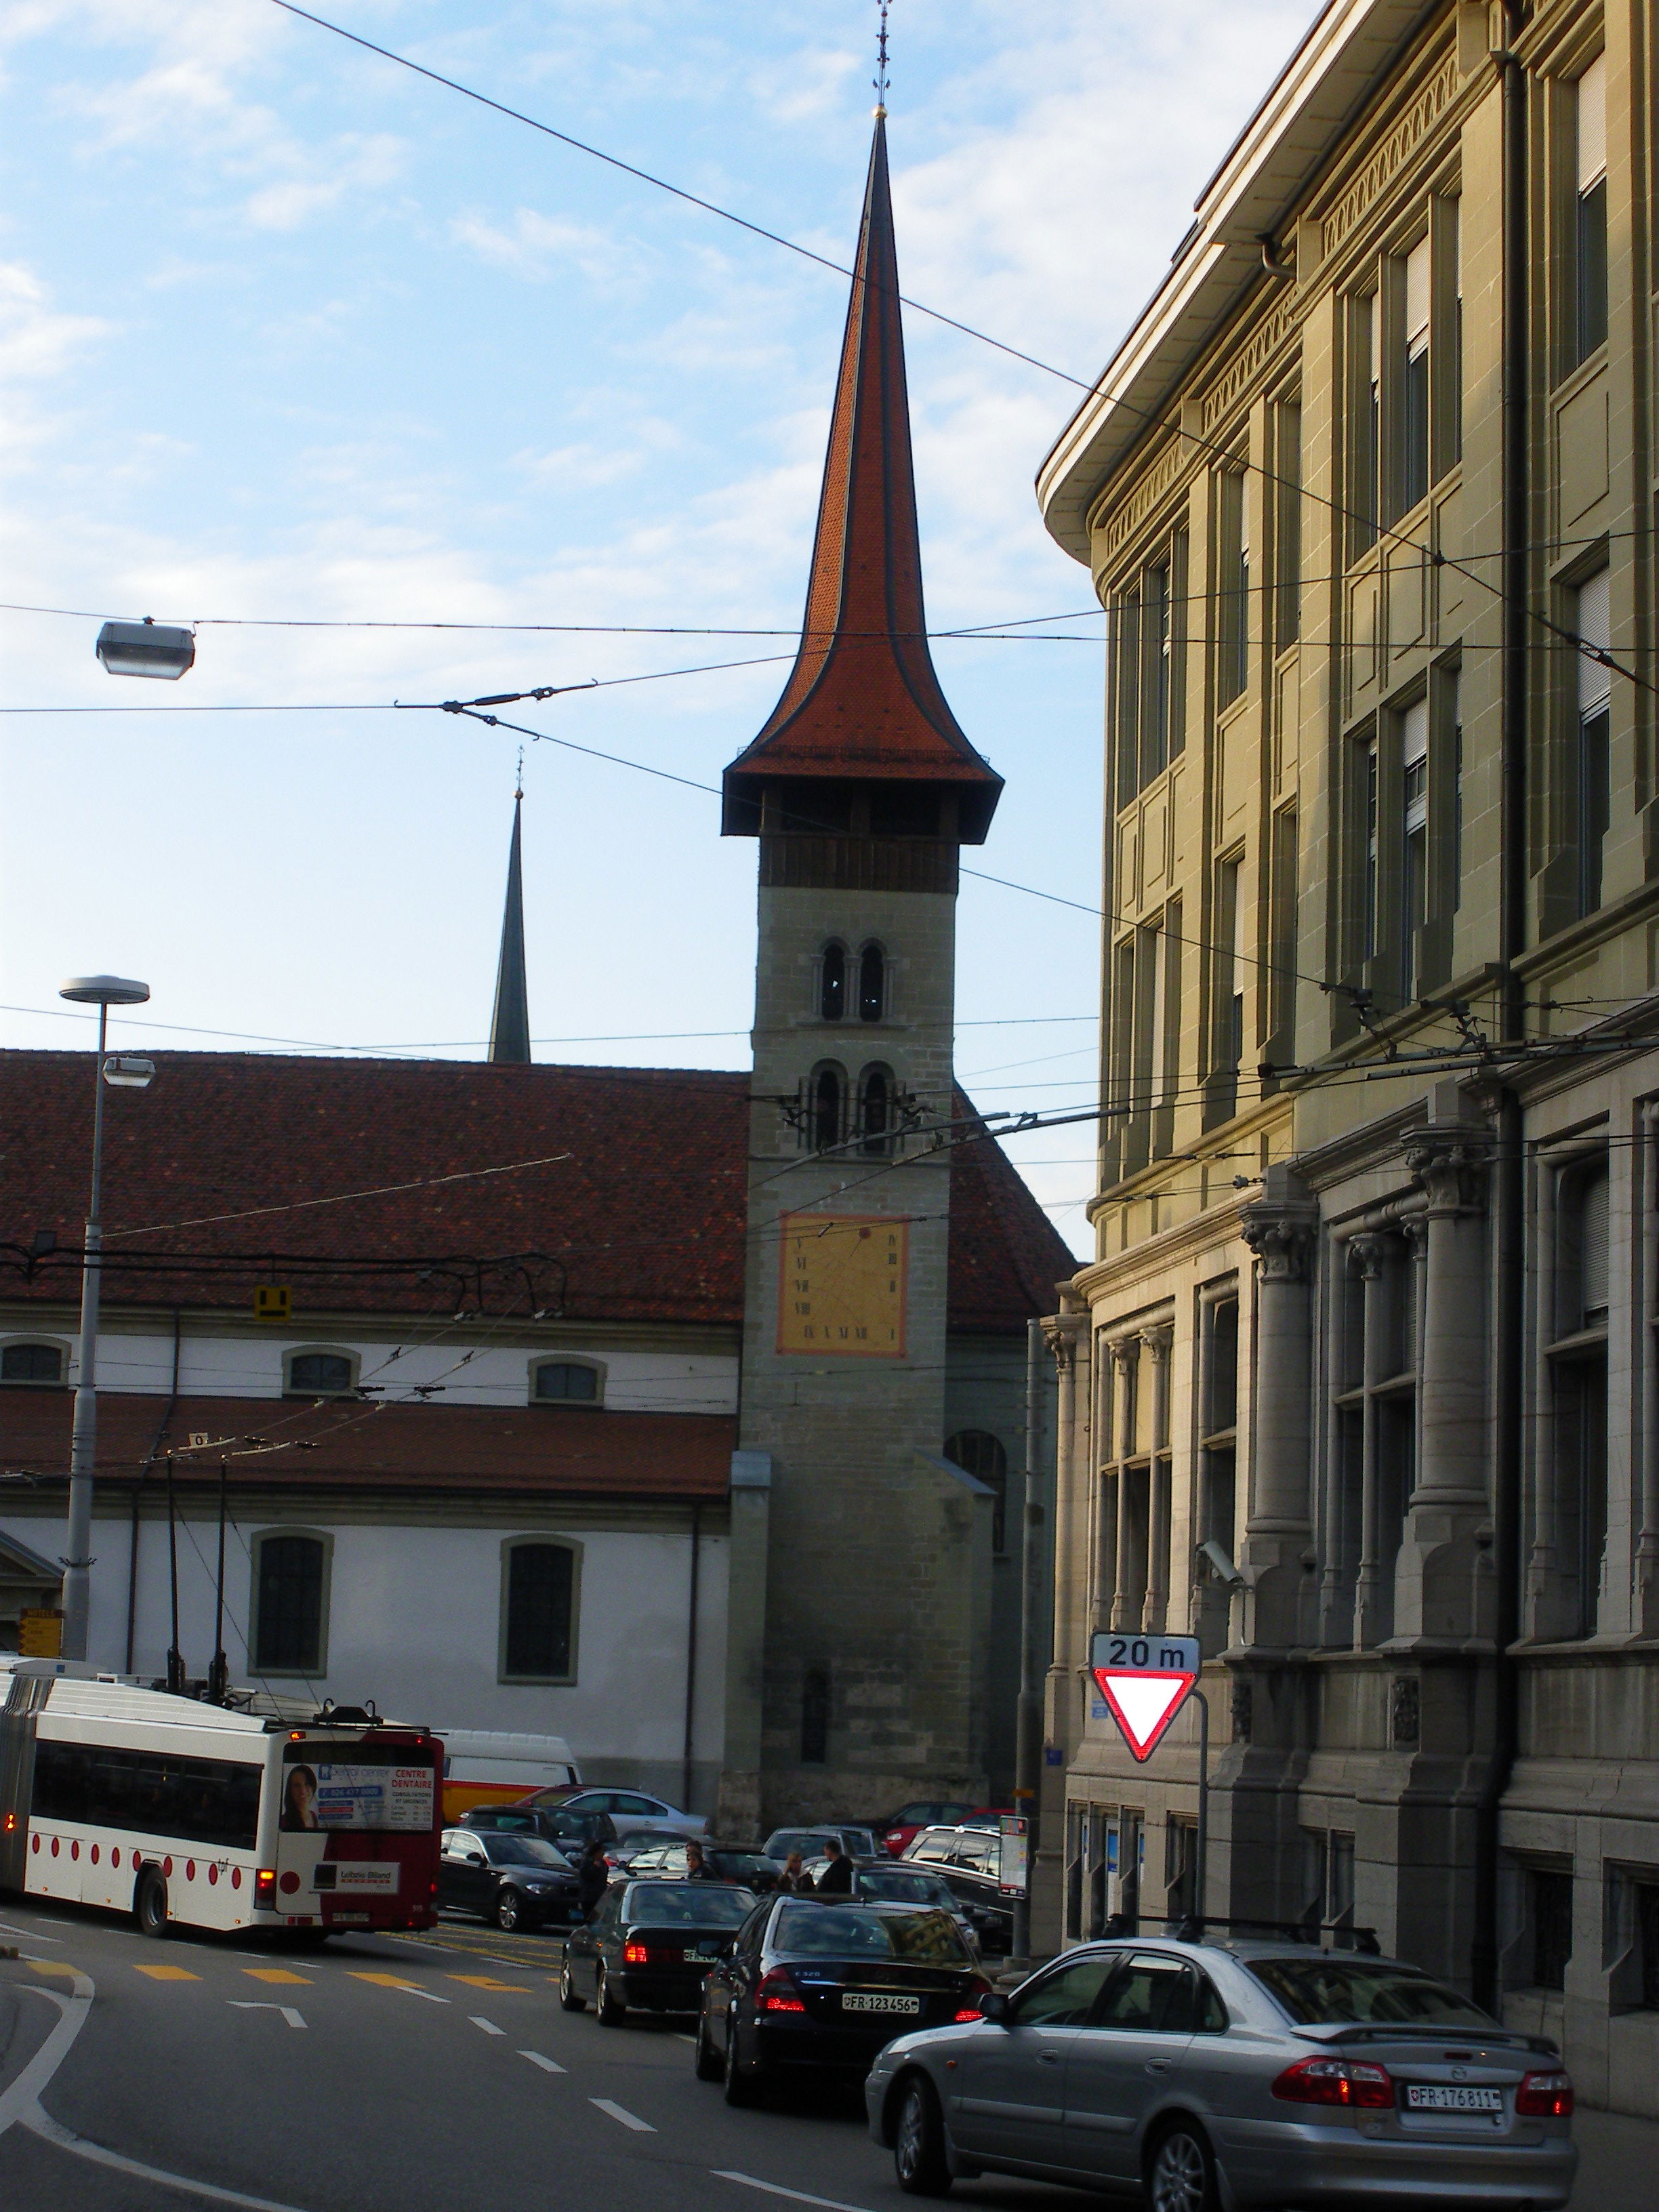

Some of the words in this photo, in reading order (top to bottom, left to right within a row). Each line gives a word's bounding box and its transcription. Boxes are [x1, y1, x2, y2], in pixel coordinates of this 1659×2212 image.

[796, 1257, 806, 1269] VI
[27, 1609, 55, 1617] HOTELS
[1109, 1639, 1149, 1667] 20
[1160, 1649, 1185, 1668] m
[395, 1769, 427, 1778] CENTRE
[392, 1780, 432, 1788] DENTAIRE
